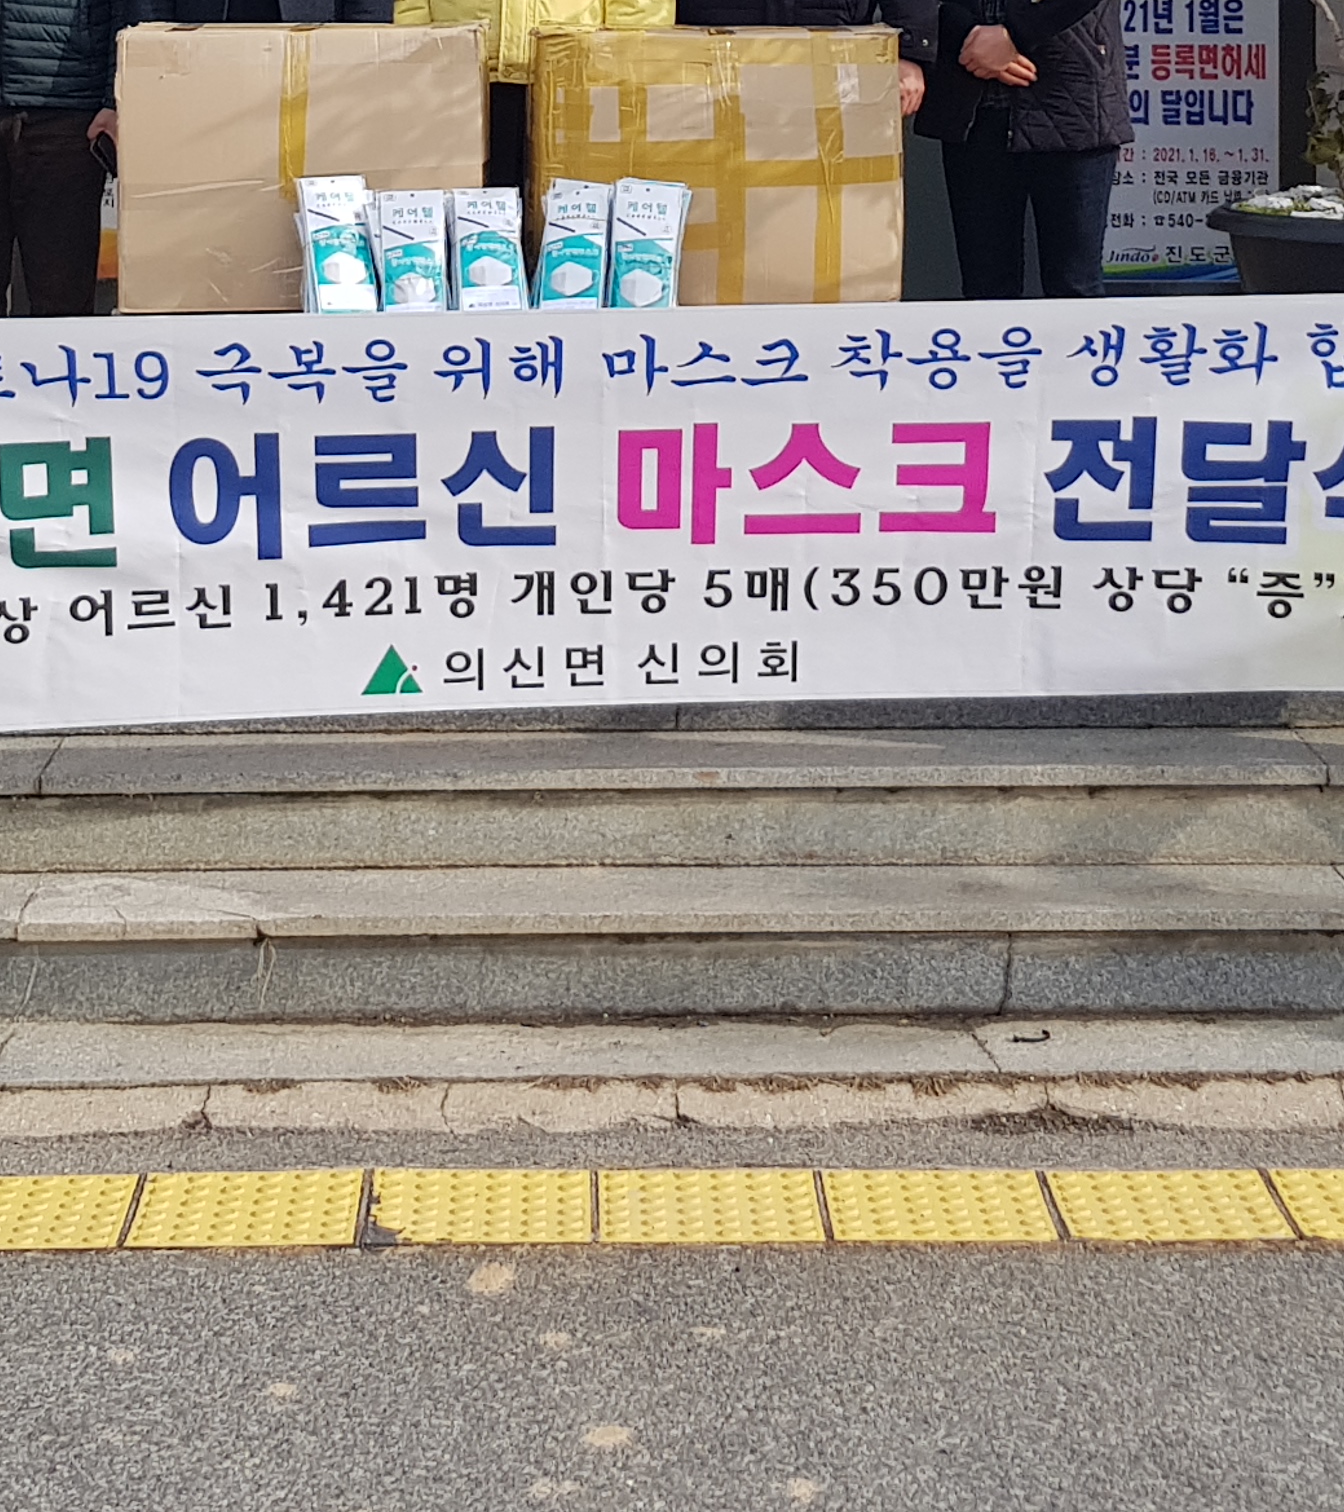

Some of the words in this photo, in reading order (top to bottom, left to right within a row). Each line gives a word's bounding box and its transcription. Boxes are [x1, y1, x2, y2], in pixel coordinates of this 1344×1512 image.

[1151, 43, 1267, 81] 등록면허세
[1160, 89, 1255, 126] 달입니다
[1153, 170, 1179, 186] 전국
[1184, 170, 1211, 186] 모든
[1217, 170, 1270, 186] 금융기관
[1111, 213, 1135, 228] 전화
[194, 337, 409, 405] 극복을
[433, 336, 566, 399] 위해
[602, 333, 811, 393] 마스크
[830, 327, 1044, 391] 착용을
[1067, 318, 1279, 390] 생활화
[168, 424, 558, 561] 어르신
[616, 421, 997, 546] 마스크
[69, 582, 233, 638] 어르신
[262, 572, 482, 626] 1,421명
[510, 567, 677, 617] 개인당
[1092, 566, 1203, 615] 상당
[442, 644, 606, 691] 의신면
[636, 640, 799, 686] 신의회
